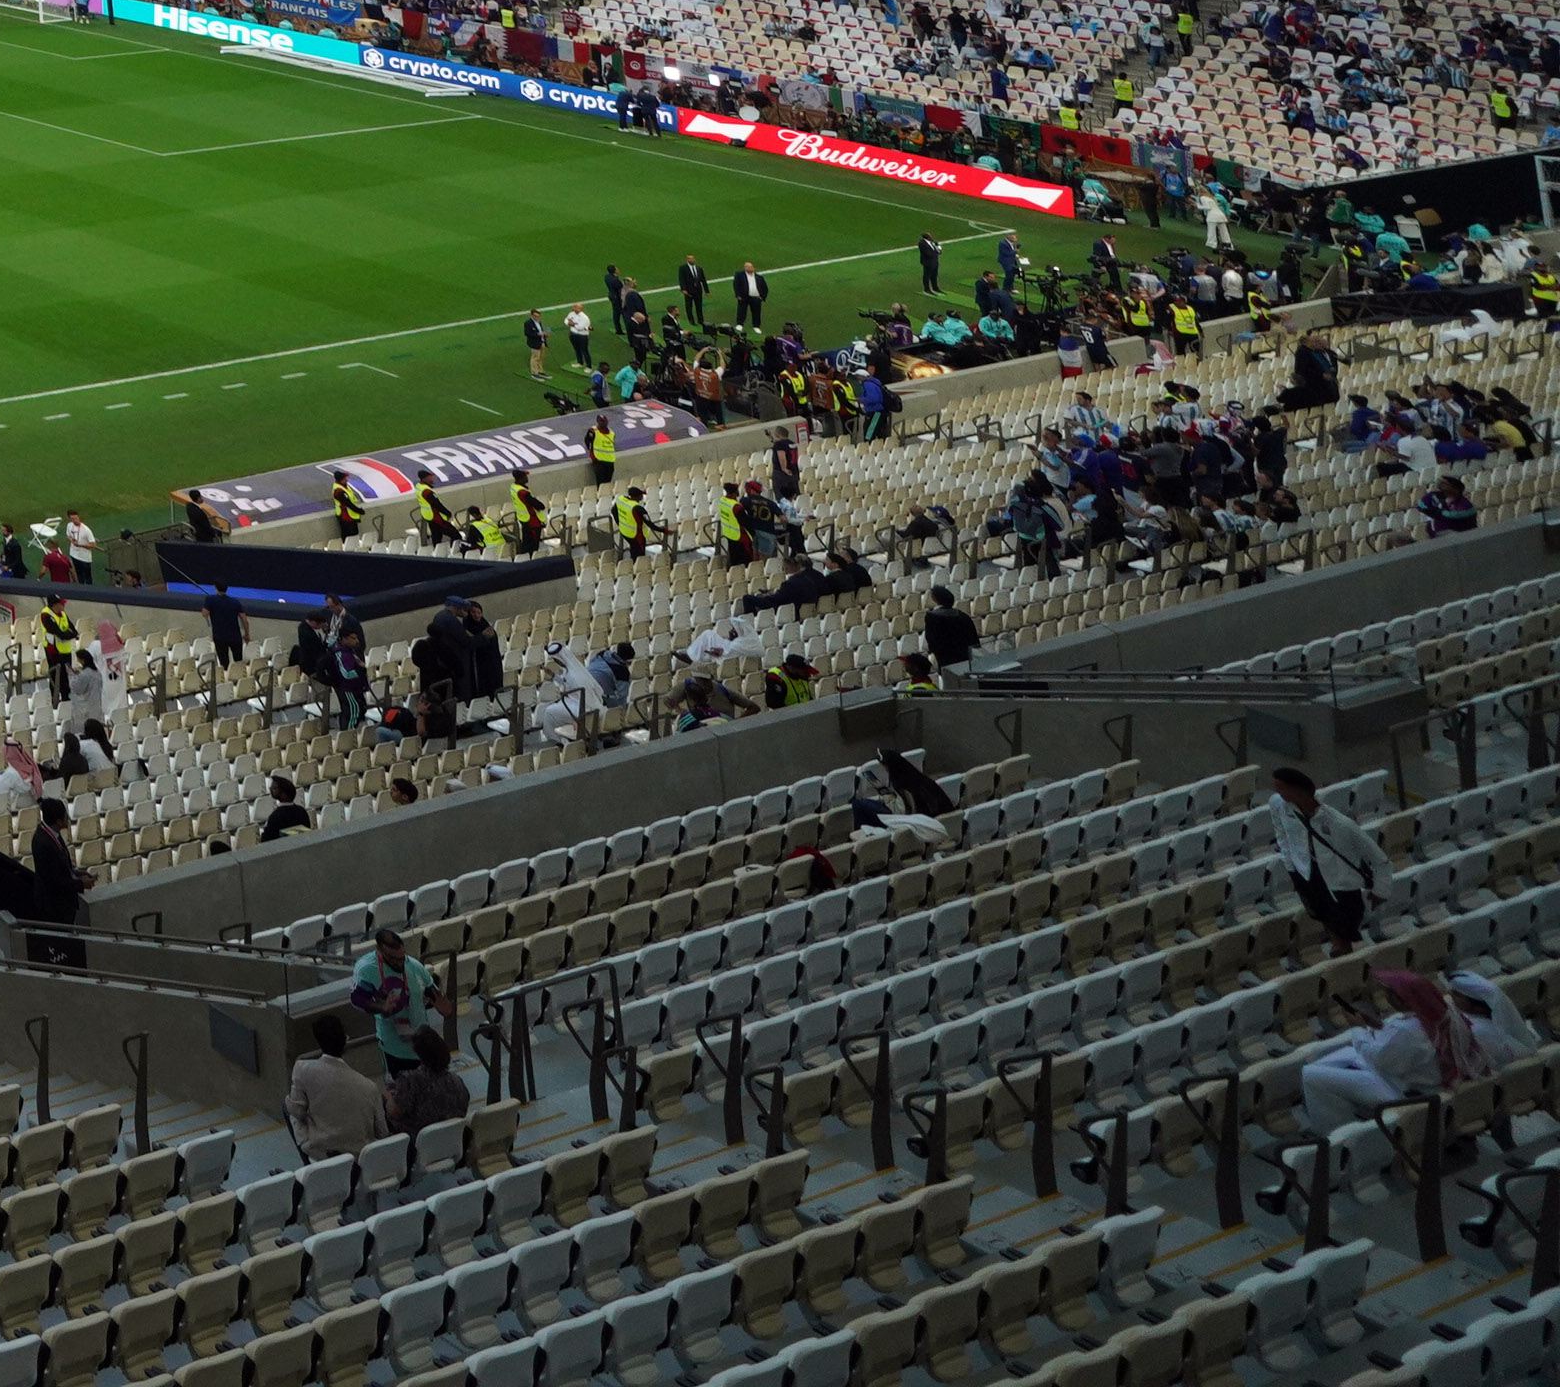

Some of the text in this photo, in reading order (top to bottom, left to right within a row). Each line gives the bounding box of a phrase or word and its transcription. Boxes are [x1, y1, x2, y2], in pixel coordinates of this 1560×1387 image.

[153, 3, 294, 52] Hisense
[389, 56, 501, 90] crypto.com
[777, 128, 958, 189] Budweiser
[401, 425, 587, 482] FRANCE
